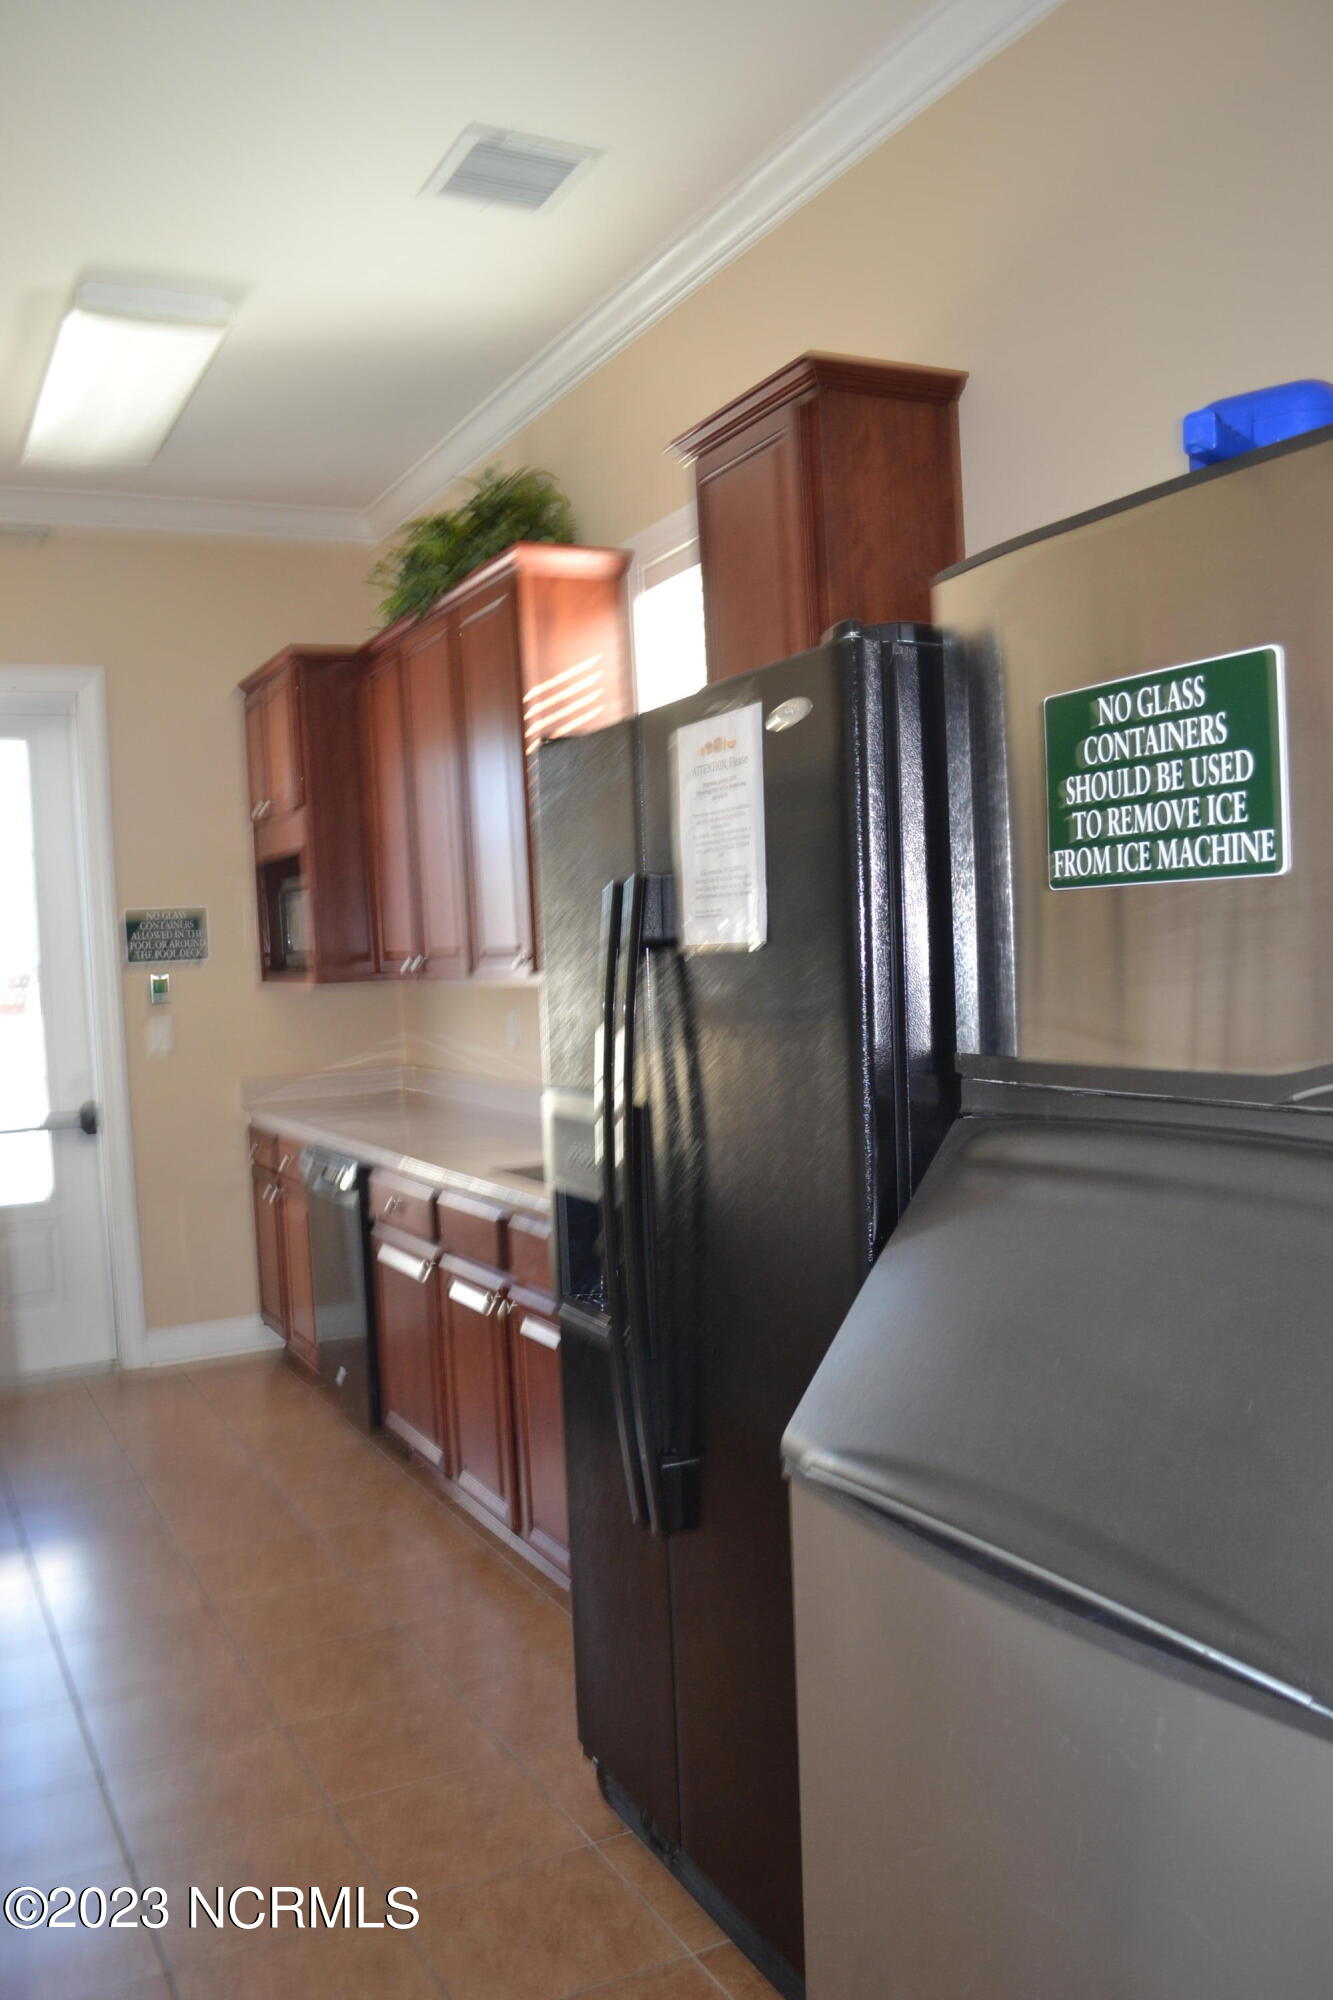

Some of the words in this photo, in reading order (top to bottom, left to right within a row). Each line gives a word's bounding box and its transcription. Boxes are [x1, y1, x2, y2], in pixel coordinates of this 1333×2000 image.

[1097, 691, 1132, 727] NO
[1137, 675, 1207, 719] GLASS
[1083, 711, 1228, 766] CONTAINERS
[1065, 765, 1151, 806] SHOULD
[1156, 759, 1185, 793] BE
[1190, 749, 1255, 788] USED
[1071, 810, 1102, 841] TO
[1107, 796, 1201, 837] REMOVE
[1206, 791, 1249, 826] ICE
[1053, 845, 1112, 879] FROM
[1117, 840, 1152, 873] ICE
[1156, 829, 1277, 870] MACHINE
[139, 919, 194, 930] CONTAINERS
[146, 911, 160, 921] NO
[161, 911, 188, 920] GLASS
[130, 940, 154, 951] POOL
[169, 938, 206, 949] AROUND
[131, 930, 173, 940] ALLOWED
[174, 929, 184, 938] IN
[187, 928, 203, 938] THE
[134, 950, 153, 960] THE
[155, 949, 176, 959] POOL
[180, 948, 202, 958] DECK
